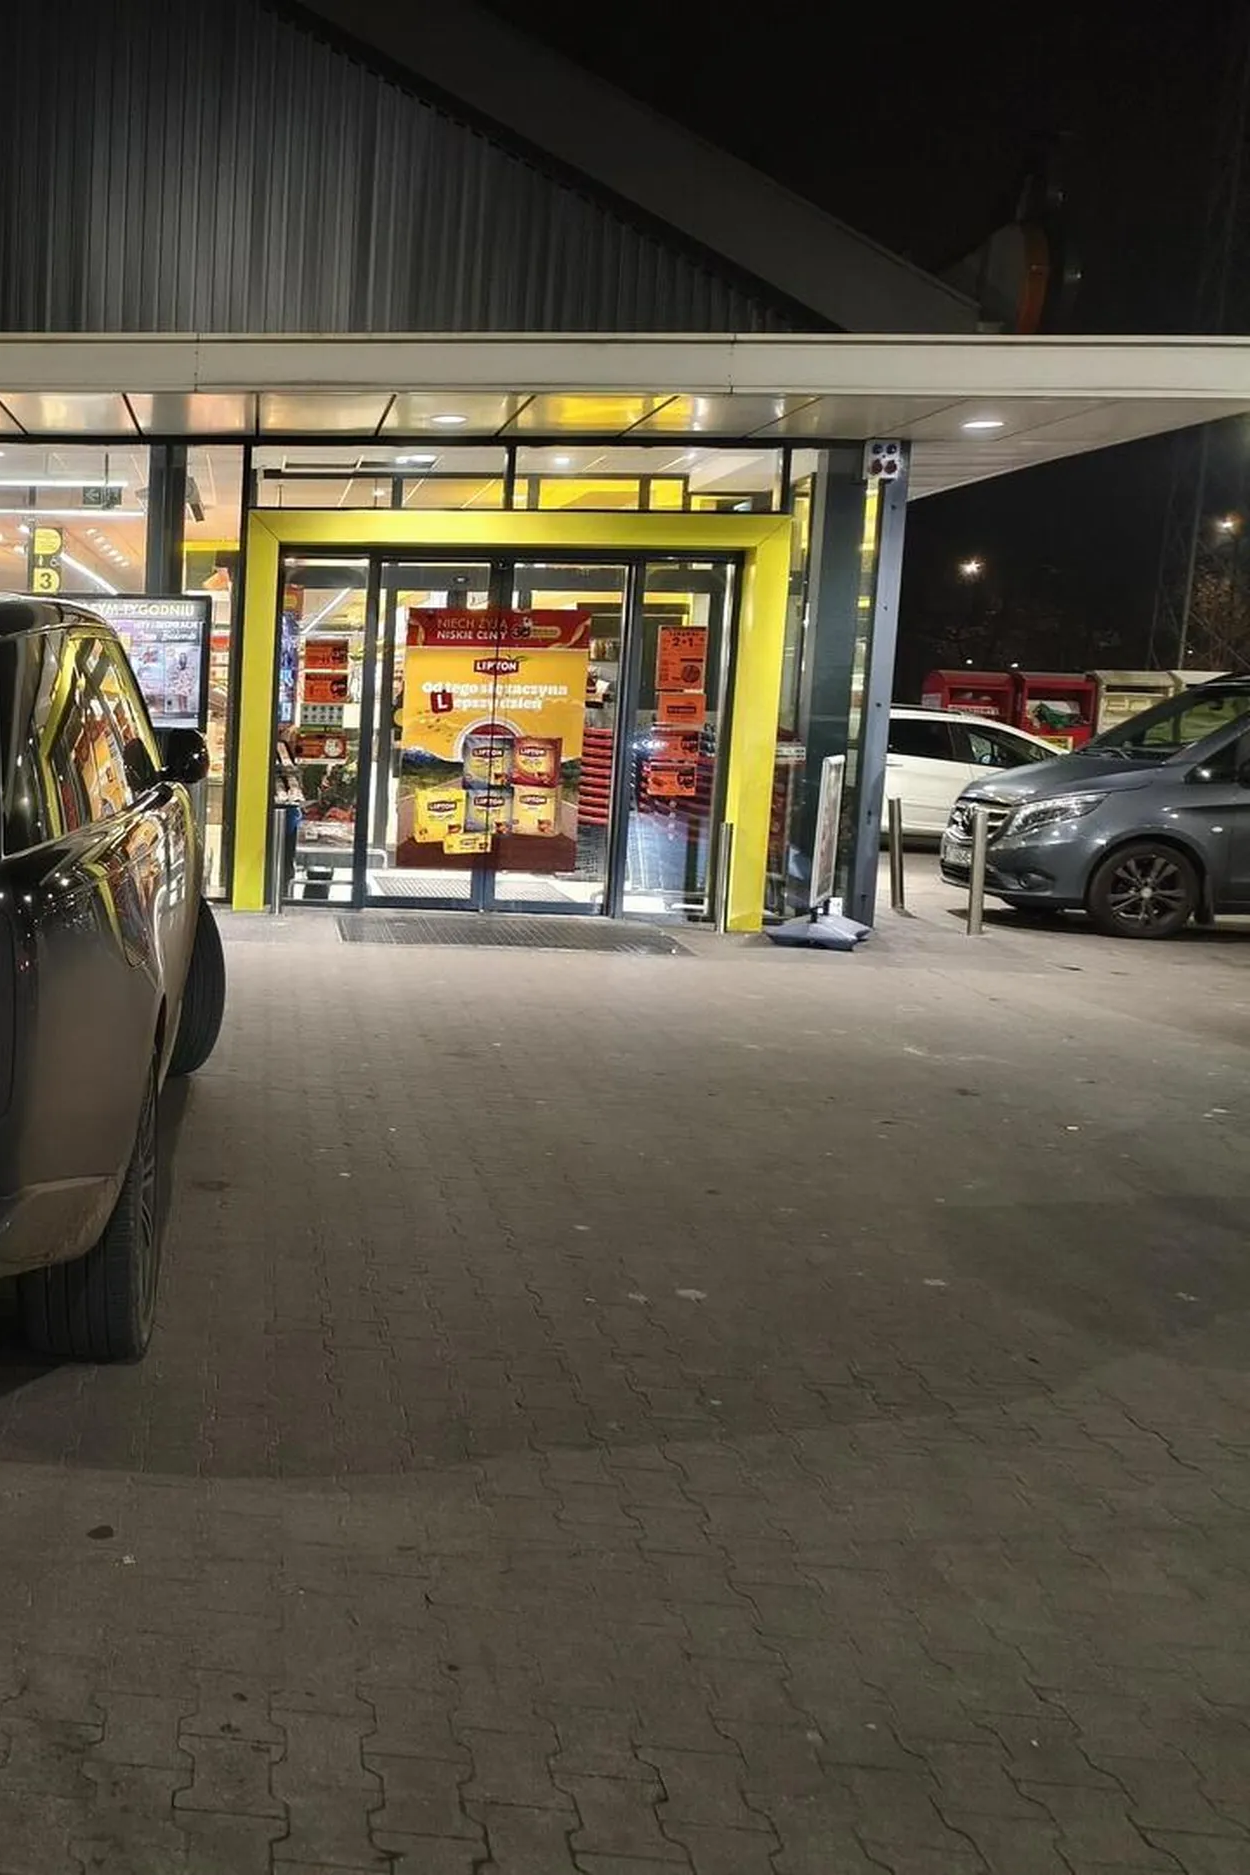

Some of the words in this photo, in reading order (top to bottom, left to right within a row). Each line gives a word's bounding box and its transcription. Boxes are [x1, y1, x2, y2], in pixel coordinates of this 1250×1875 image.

[39, 573, 52, 589] 3
[437, 617, 475, 629] NIECH
[475, 660, 518, 672] LIPTON
